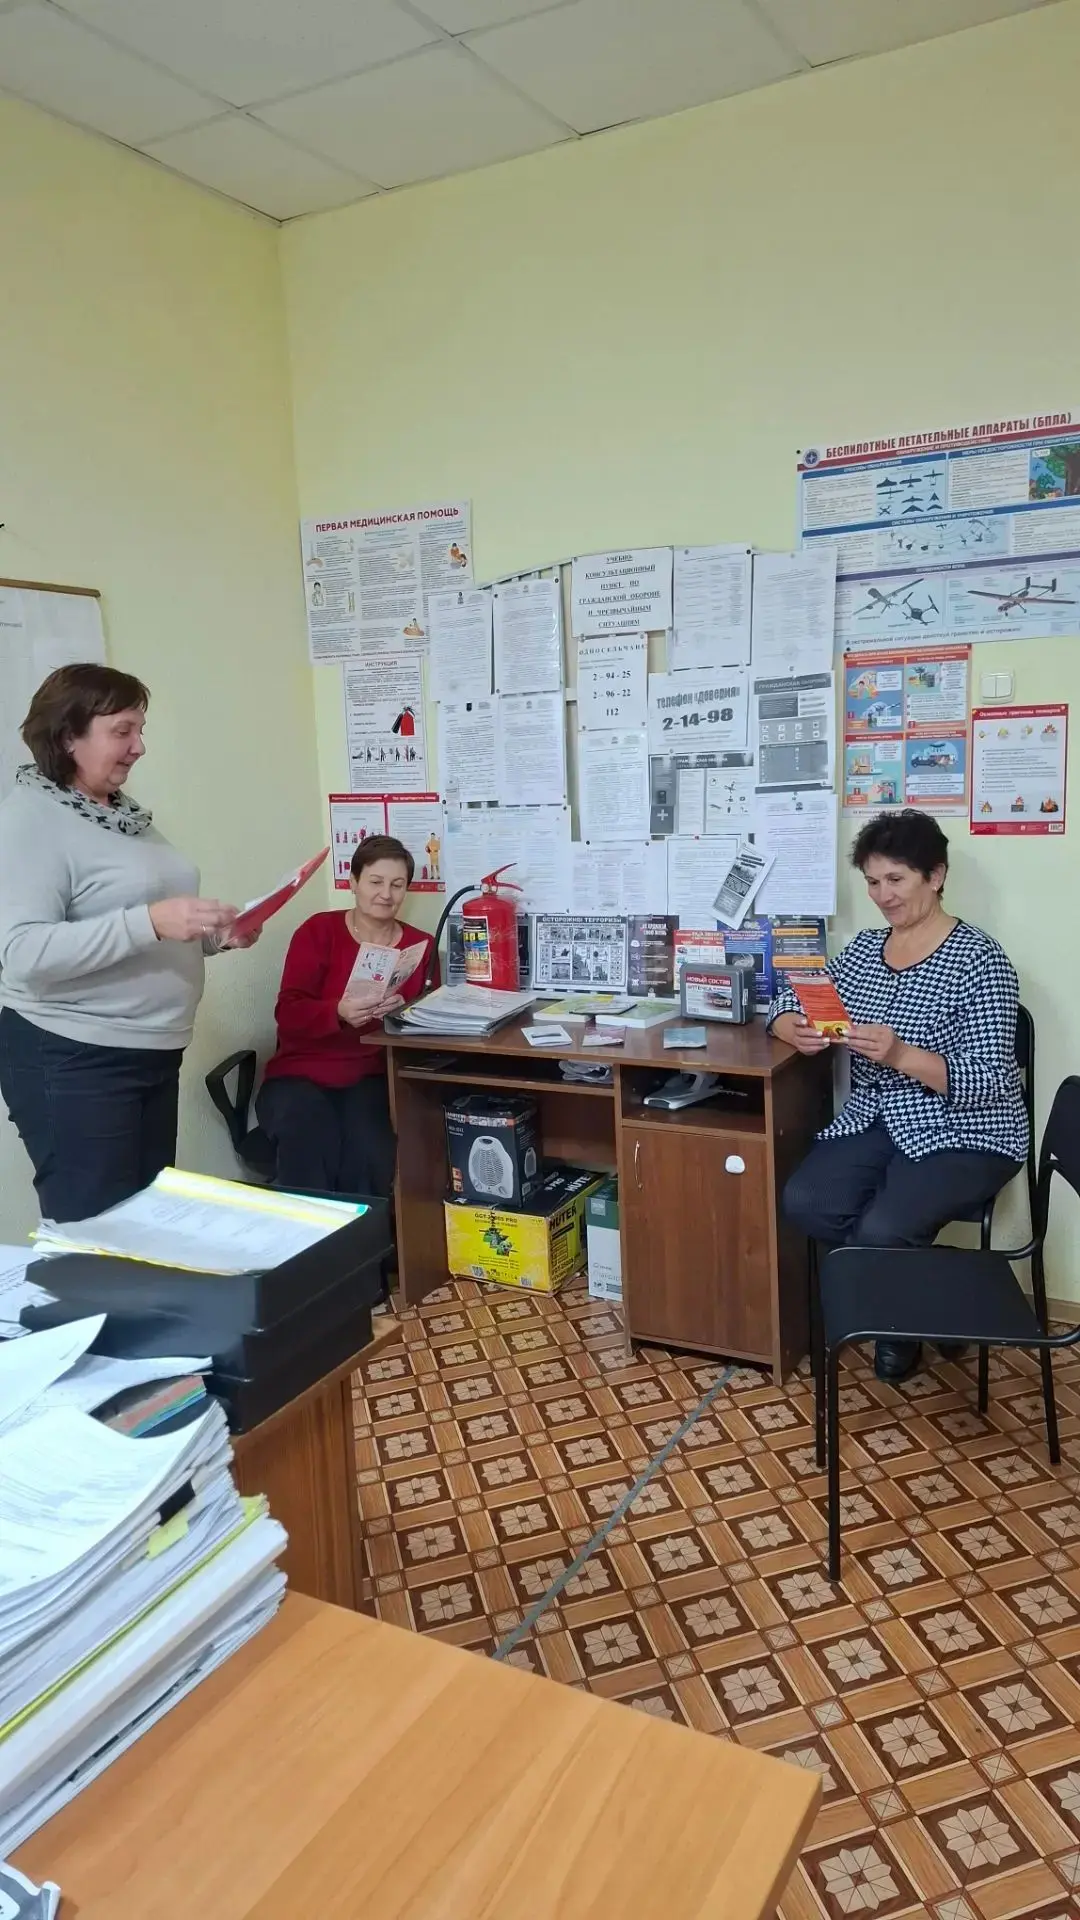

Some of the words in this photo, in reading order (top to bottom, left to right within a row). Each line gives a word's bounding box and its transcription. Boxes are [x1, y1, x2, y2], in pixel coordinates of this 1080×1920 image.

[826, 437, 897, 458] БЕСПИЛОТНЫЕ
[898, 427, 970, 448] ЛЕТАТЕЛЬНЫЕ
[972, 418, 1030, 437] АППАРАТЫ
[1032, 412, 1072, 428] (БПЛА)
[315, 520, 349, 533] ПЕРВАЯ
[350, 512, 416, 529] МЕДИЦИНСКАЯ
[417, 507, 459, 521] ПОМОЩЬ
[585, 564, 656, 579] КОНСУЛЬТАЦИОННЫЙ
[578, 593, 627, 605] ГРАЖДАНСКОЙ
[630, 590, 661, 600] ОБОРОНЕ
[596, 604, 652, 615] ЧРЕЗВЫЧАЙНЫМ
[598, 619, 641, 628] СИТУАЦИЯМ
[364, 660, 398, 668] ИНСТРУКЦИЯ
[606, 707, 619, 717] 112
[662, 708, 734, 731] 2-14-98
[686, 974, 708, 984] НОВЫЙ
[708, 978, 731, 986] СОСТАВ
